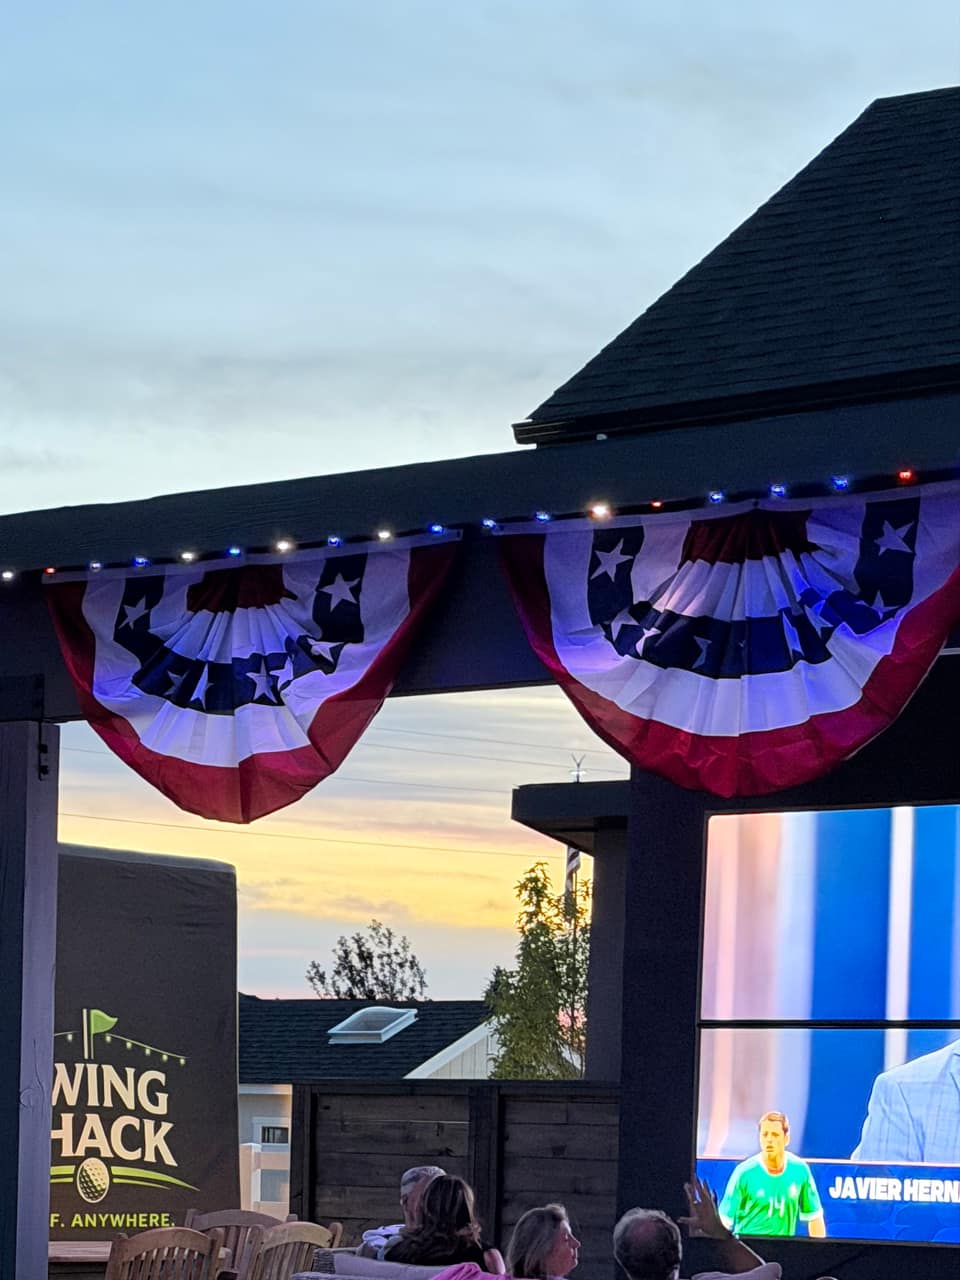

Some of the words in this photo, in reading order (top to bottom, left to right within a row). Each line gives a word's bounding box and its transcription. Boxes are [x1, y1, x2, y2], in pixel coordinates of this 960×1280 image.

[52, 1063, 168, 1115] WING
[50, 1113, 178, 1167] HACK
[829, 1176, 902, 1201] JAVIER
[903, 1178, 960, 1203] HERN
[71, 1213, 175, 1227] ANYWHERE.
[768, 1196, 785, 1217] 14
